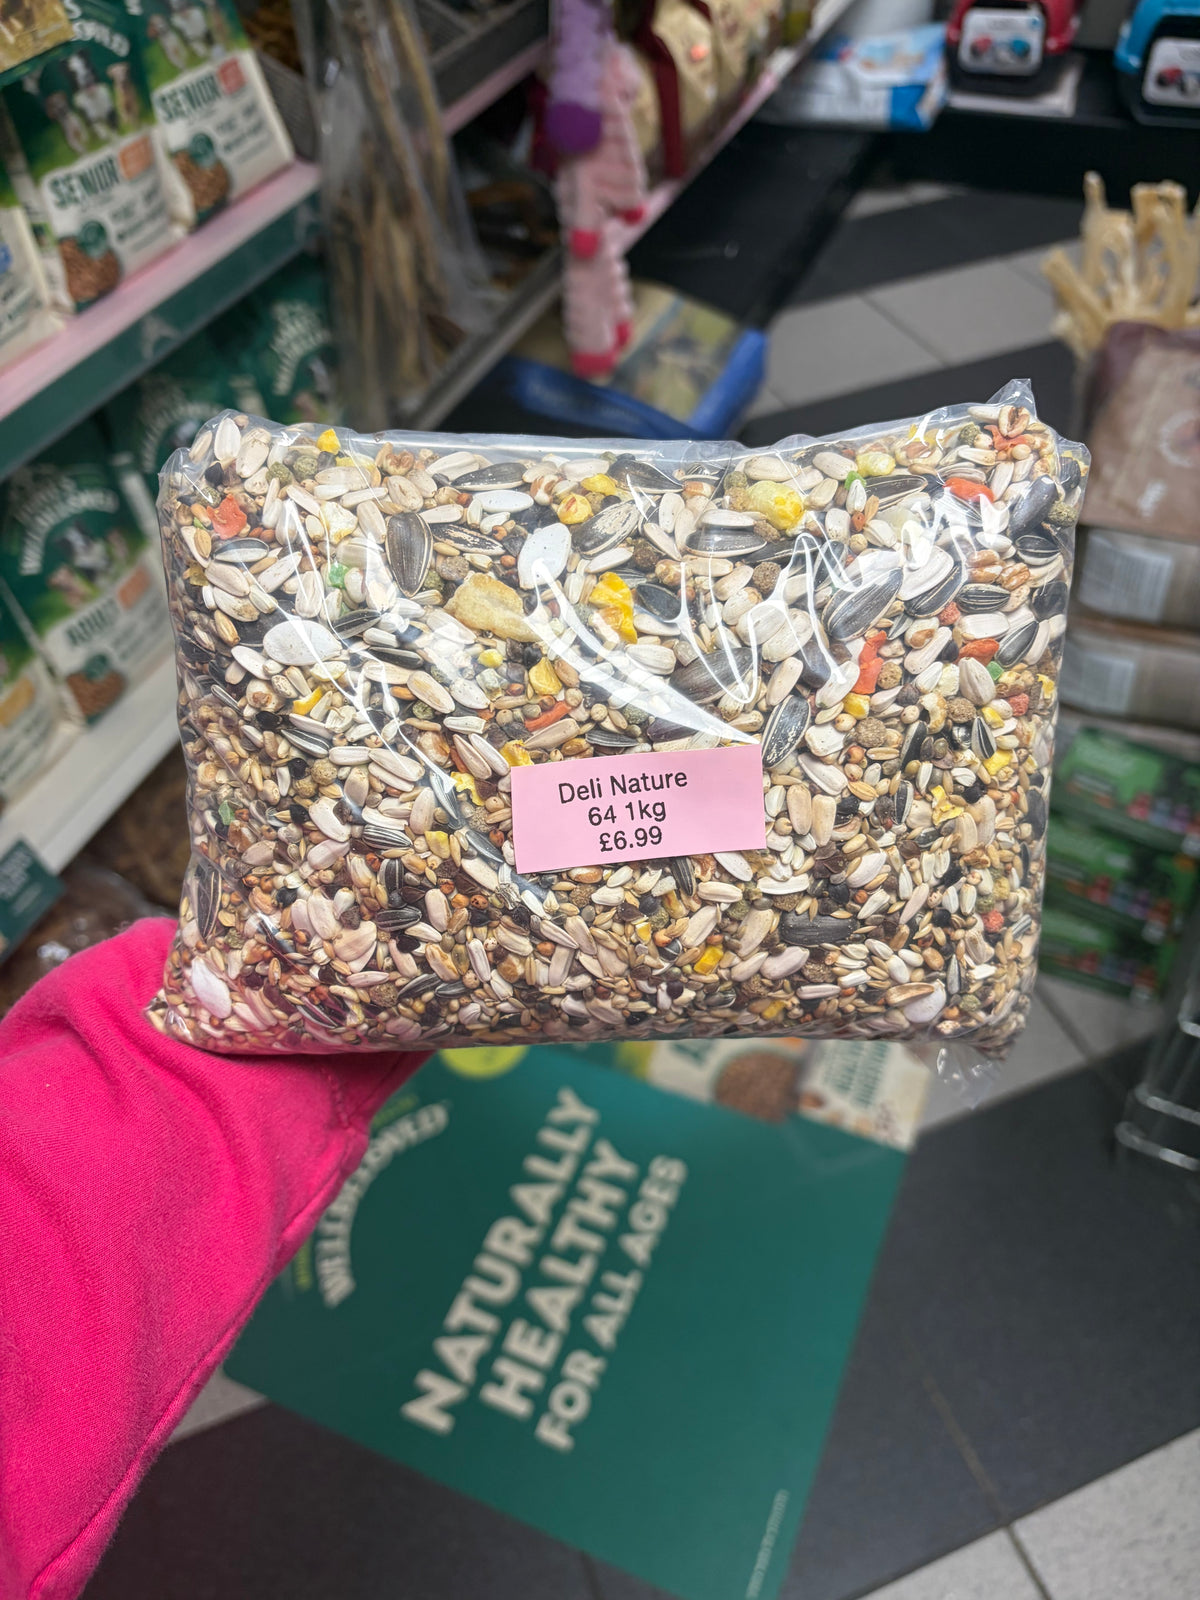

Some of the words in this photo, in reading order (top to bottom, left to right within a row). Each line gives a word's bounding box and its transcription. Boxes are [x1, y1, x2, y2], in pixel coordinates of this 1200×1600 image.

[160, 74, 222, 121] SENIOR
[50, 156, 120, 209] SENIOR
[558, 777, 603, 804] Deli
[610, 771, 688, 796] Nature
[588, 804, 617, 826] 64
[625, 799, 667, 822] 1kg
[599, 825, 662, 852] £6.99
[400, 1087, 600, 1435] NATURALLY
[479, 1138, 638, 1420] HEALTHY
[534, 1349, 607, 1452] FOR
[583, 1269, 643, 1350] ALL
[618, 1155, 687, 1268] AGES
